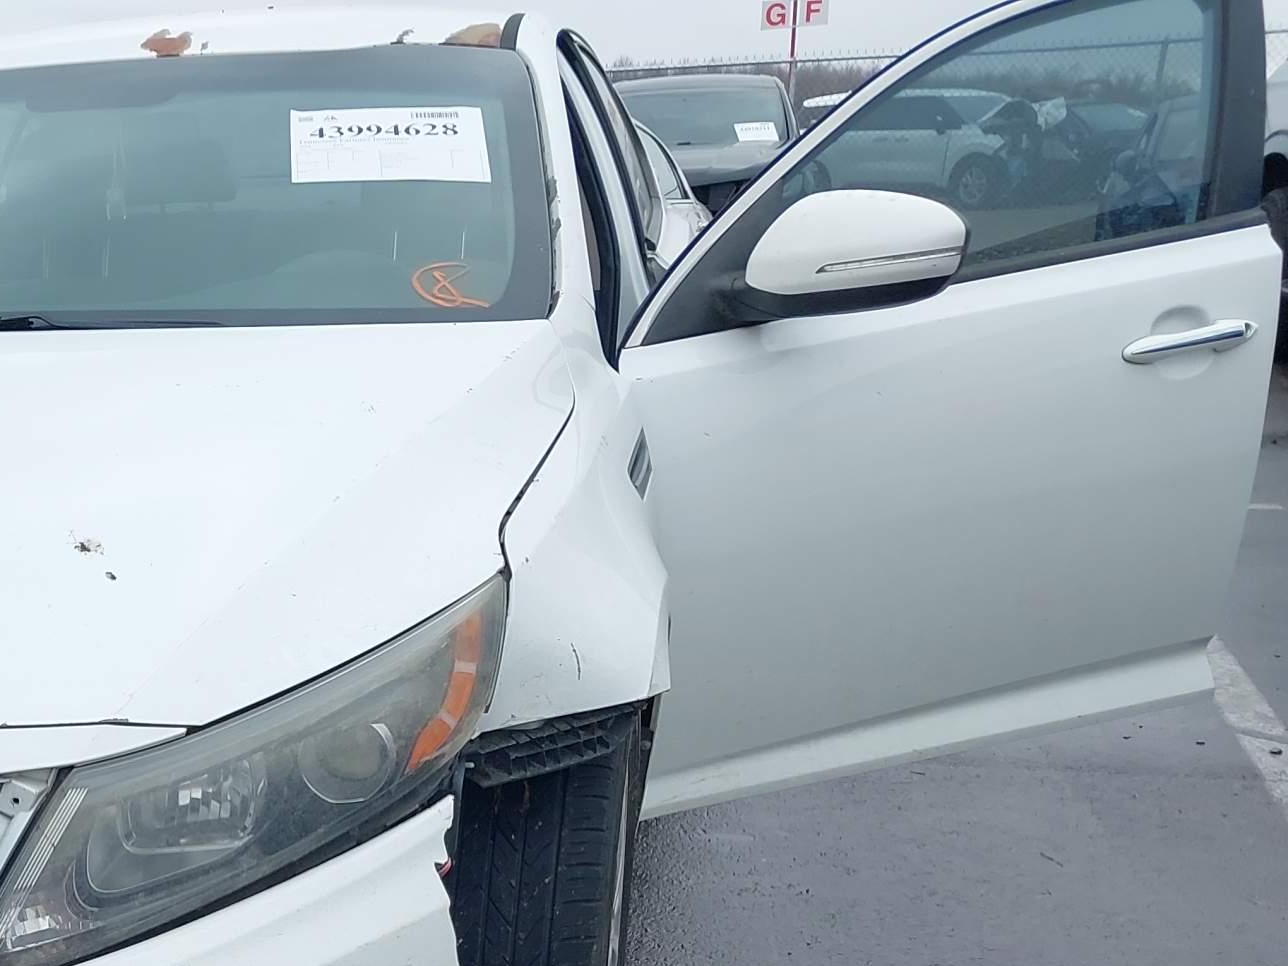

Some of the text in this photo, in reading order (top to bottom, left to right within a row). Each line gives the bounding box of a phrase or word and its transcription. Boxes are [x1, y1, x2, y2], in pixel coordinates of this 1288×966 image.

[765, 0, 823, 26] G F
[309, 123, 459, 138] 43994628
